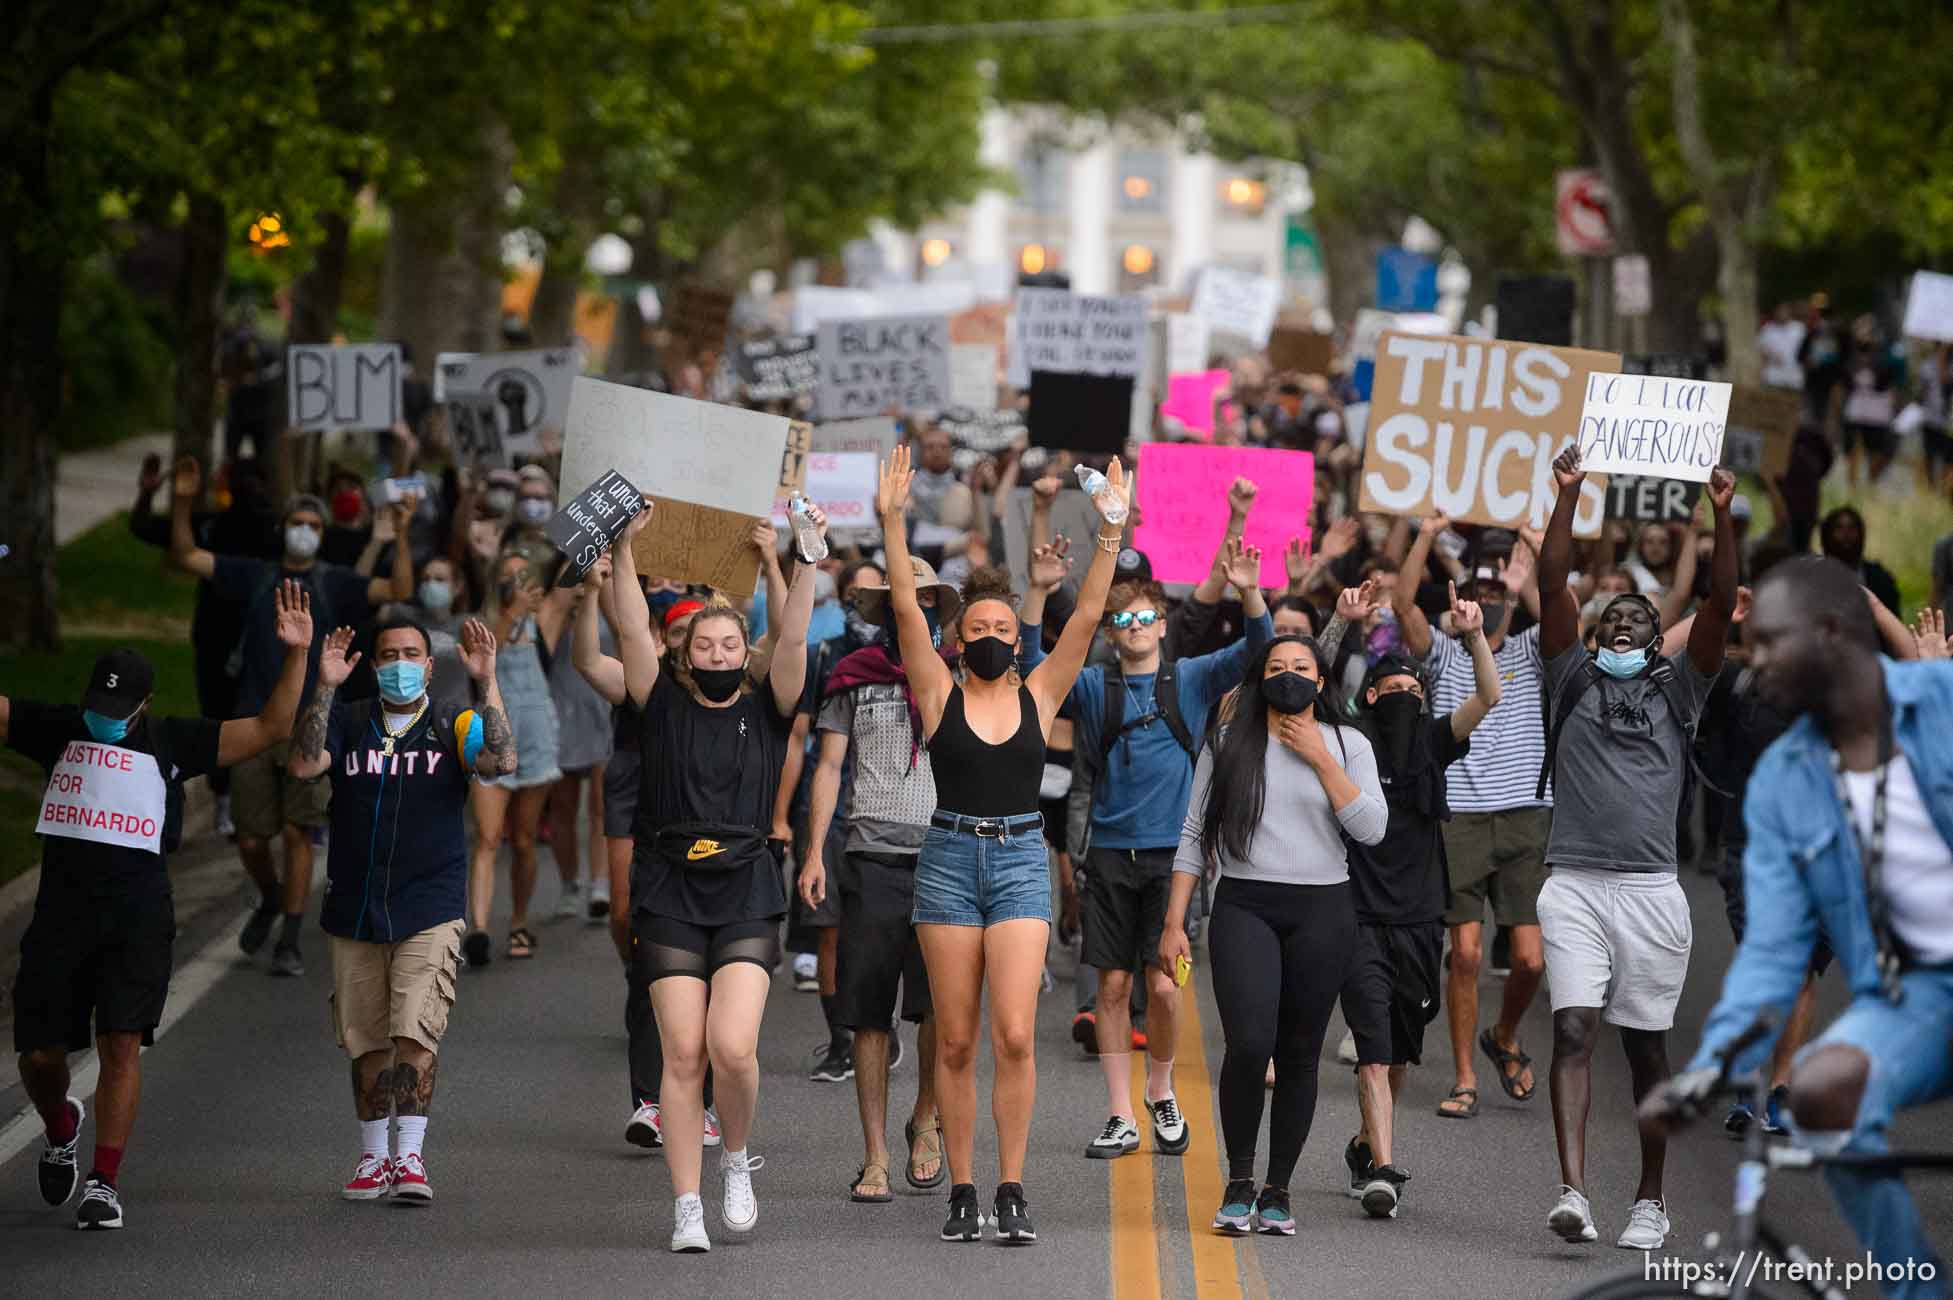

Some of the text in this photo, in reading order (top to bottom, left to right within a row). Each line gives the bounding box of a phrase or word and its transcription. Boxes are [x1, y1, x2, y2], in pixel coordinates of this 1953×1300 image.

[836, 321, 944, 354] BLACK
[295, 350, 395, 424] BLM
[1387, 336, 1570, 417] THIS
[1589, 375, 1716, 414] DO I LOOK
[1578, 416, 1724, 468] DANGEROUS?
[599, 471, 617, 487] I
[586, 489, 617, 519] that
[105, 673, 120, 689] 3
[345, 748, 443, 777] UNITY
[50, 773, 83, 795] FOR
[43, 803, 157, 838] BERNARDO
[692, 839, 721, 853] NIKE
